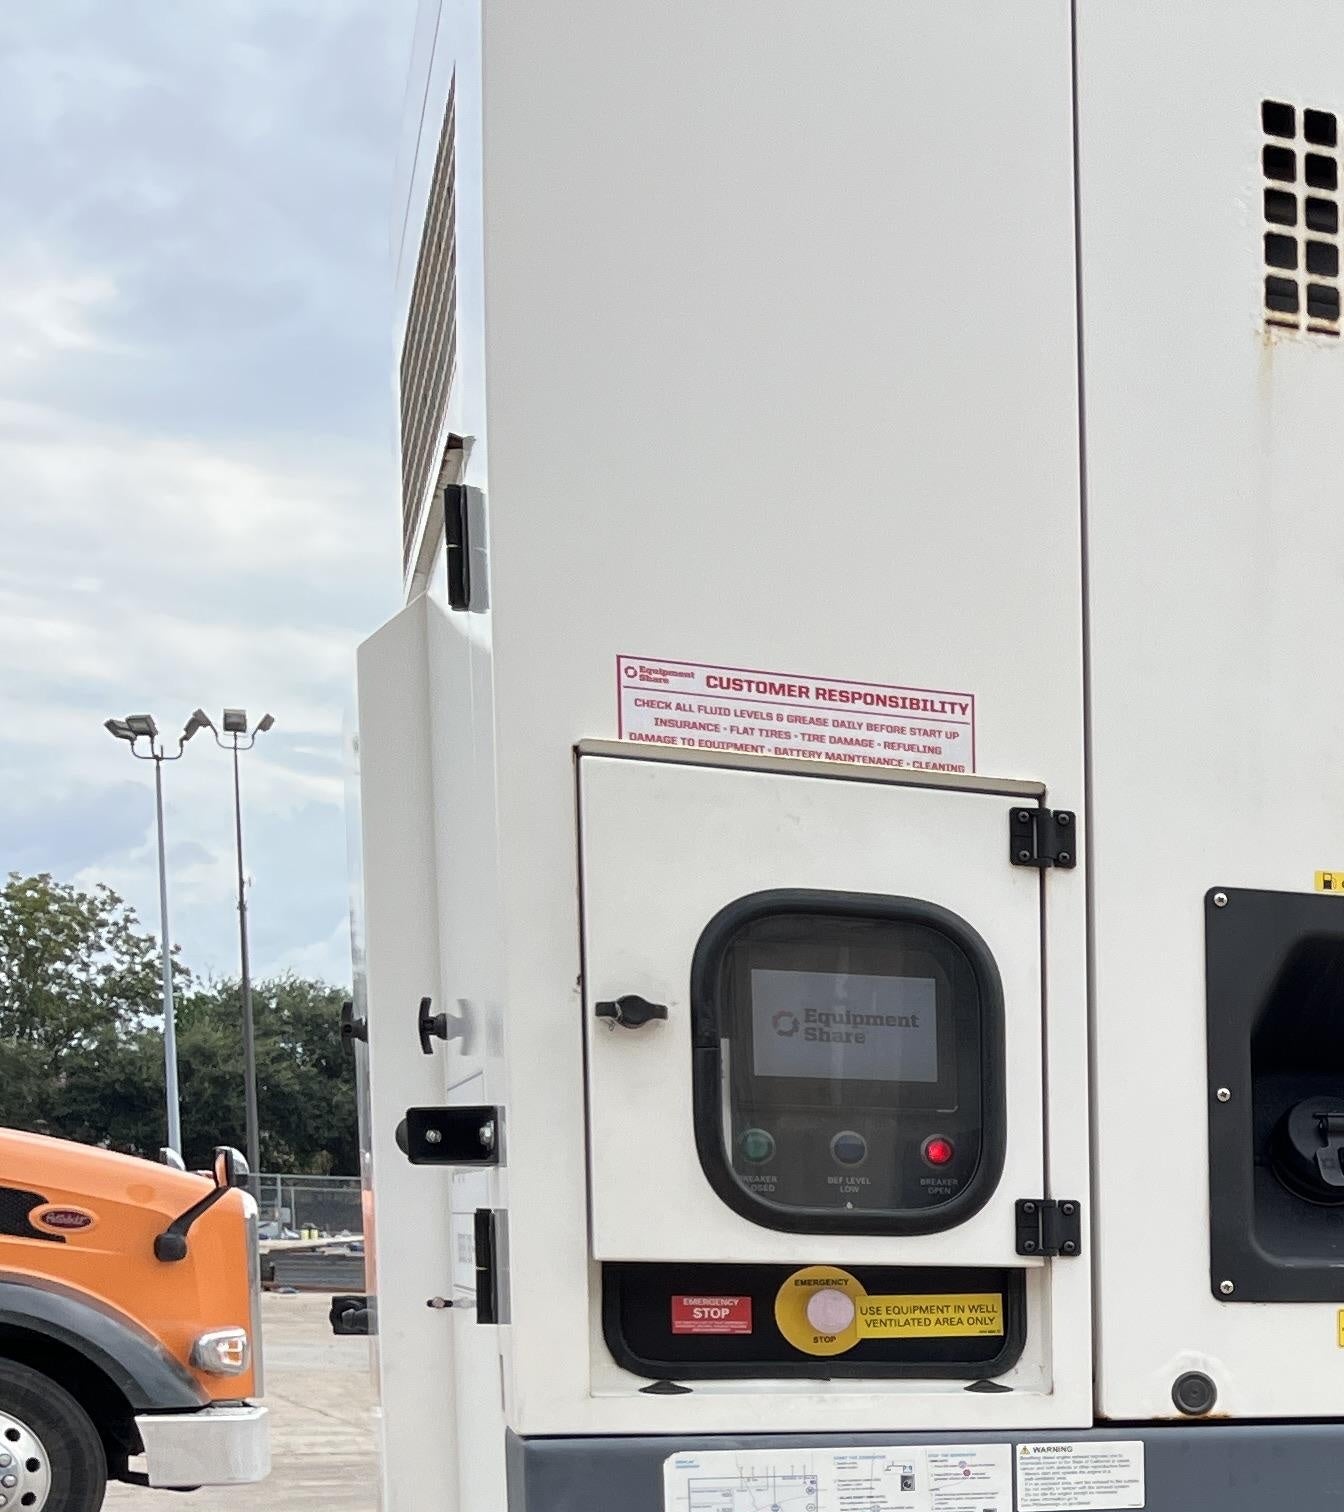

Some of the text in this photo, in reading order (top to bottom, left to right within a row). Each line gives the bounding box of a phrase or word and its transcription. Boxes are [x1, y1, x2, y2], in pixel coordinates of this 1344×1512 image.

[639, 665, 695, 679] Equipment
[639, 674, 670, 684] Share
[706, 675, 969, 716] CUSTOMER RESPONSIBILITY
[634, 698, 673, 711] CHECK
[675, 703, 694, 713] ALL
[698, 705, 731, 717] FLUID
[734, 707, 773, 721] LEVELS
[786, 713, 829, 727] GREASE
[832, 719, 863, 731] DAILY
[866, 722, 907, 735] BEFORE
[909, 727, 943, 739] START
[944, 731, 960, 740] UP
[654, 717, 942, 756] INSURANCE FLAT TIRES TIRE DAMAGE REFUELING
[629, 732, 965, 773] DAMAGE TO EQUIPMENT BATTERY MAINTENANCE CLEANING
[803, 1008, 920, 1029] Equipment
[803, 1026, 866, 1044] Share
[846, 1177, 871, 1185] LEVEL
[840, 1184, 859, 1194] LOW
[794, 1278, 849, 1287] EMERGENCY
[683, 1297, 739, 1306] EMERGENCY
[692, 1307, 730, 1319] STOP
[860, 1304, 998, 1315] USE EQUIPMENT IN WELL
[865, 1316, 996, 1328] VENTILATED AREA ONLY
[813, 1335, 837, 1344] STOP
[1032, 1445, 1074, 1453] WARNING
